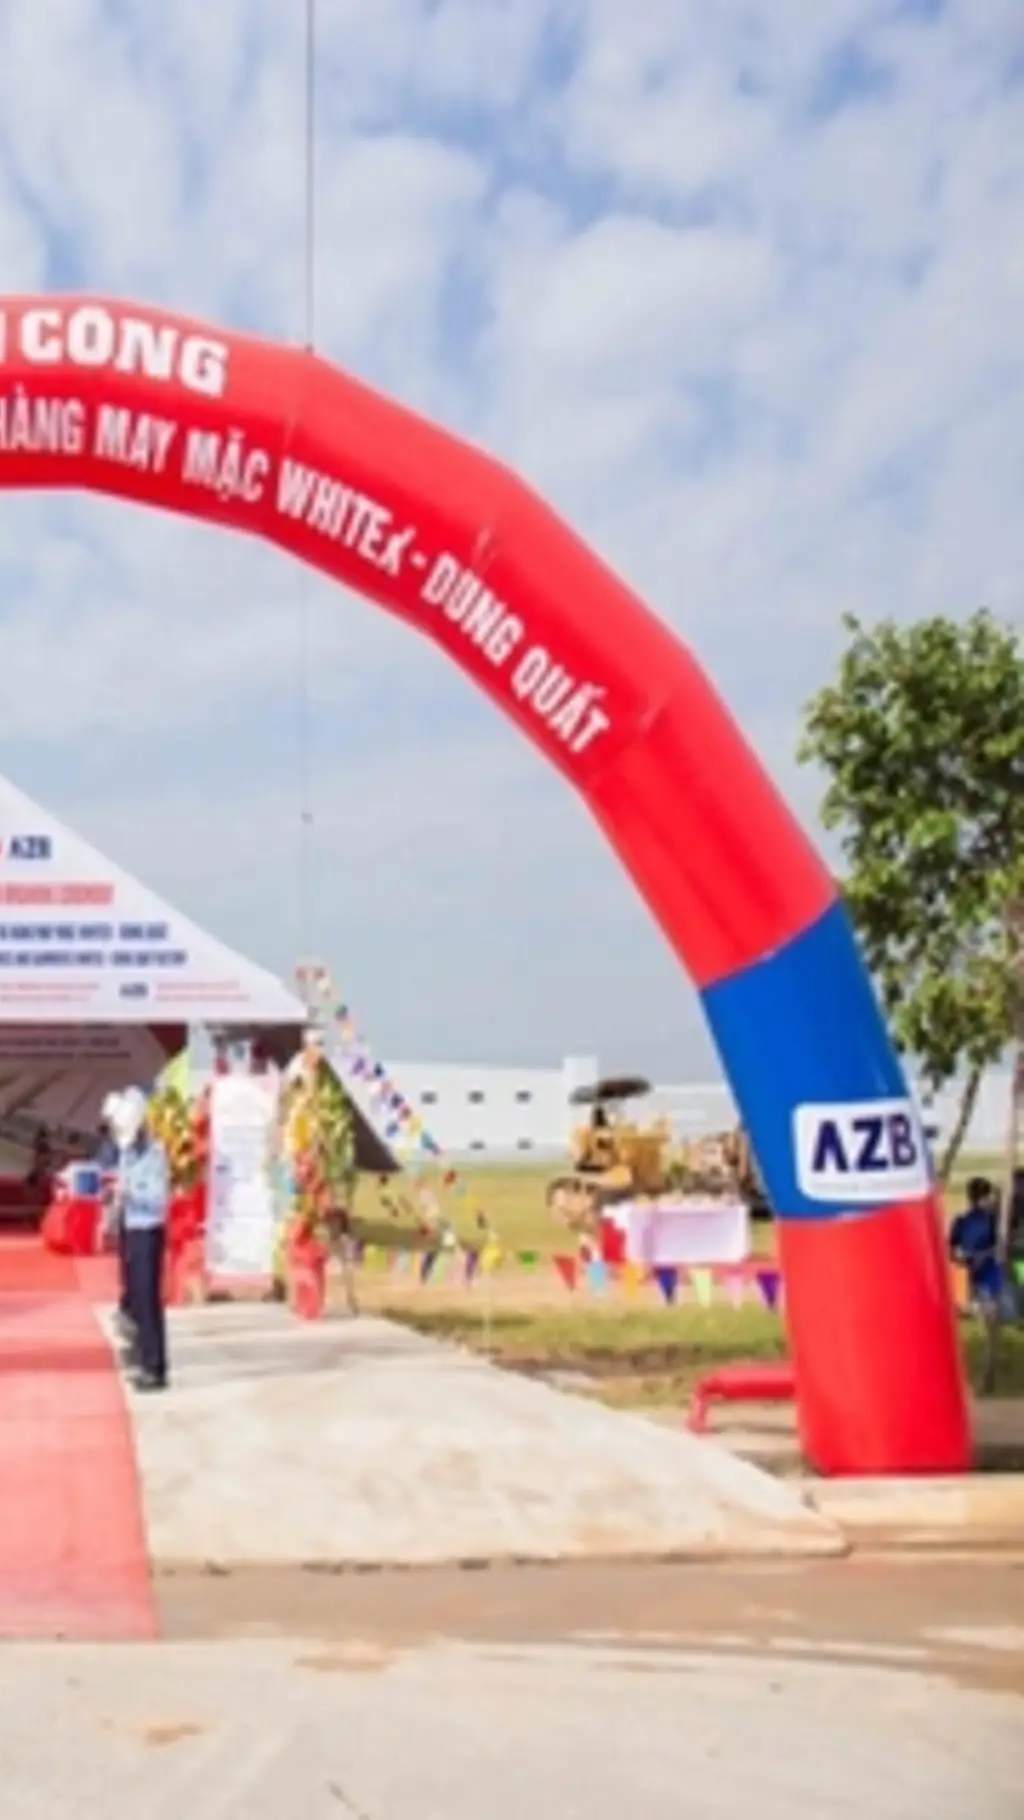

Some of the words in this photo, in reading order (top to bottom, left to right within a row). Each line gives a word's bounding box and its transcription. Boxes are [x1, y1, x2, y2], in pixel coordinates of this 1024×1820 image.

[20, 305, 229, 397] CÔNG
[94, 402, 177, 473] MAY
[182, 427, 269, 502] MẶC
[419, 551, 526, 668] DUNG
[811, 1112, 918, 1172] AZB
